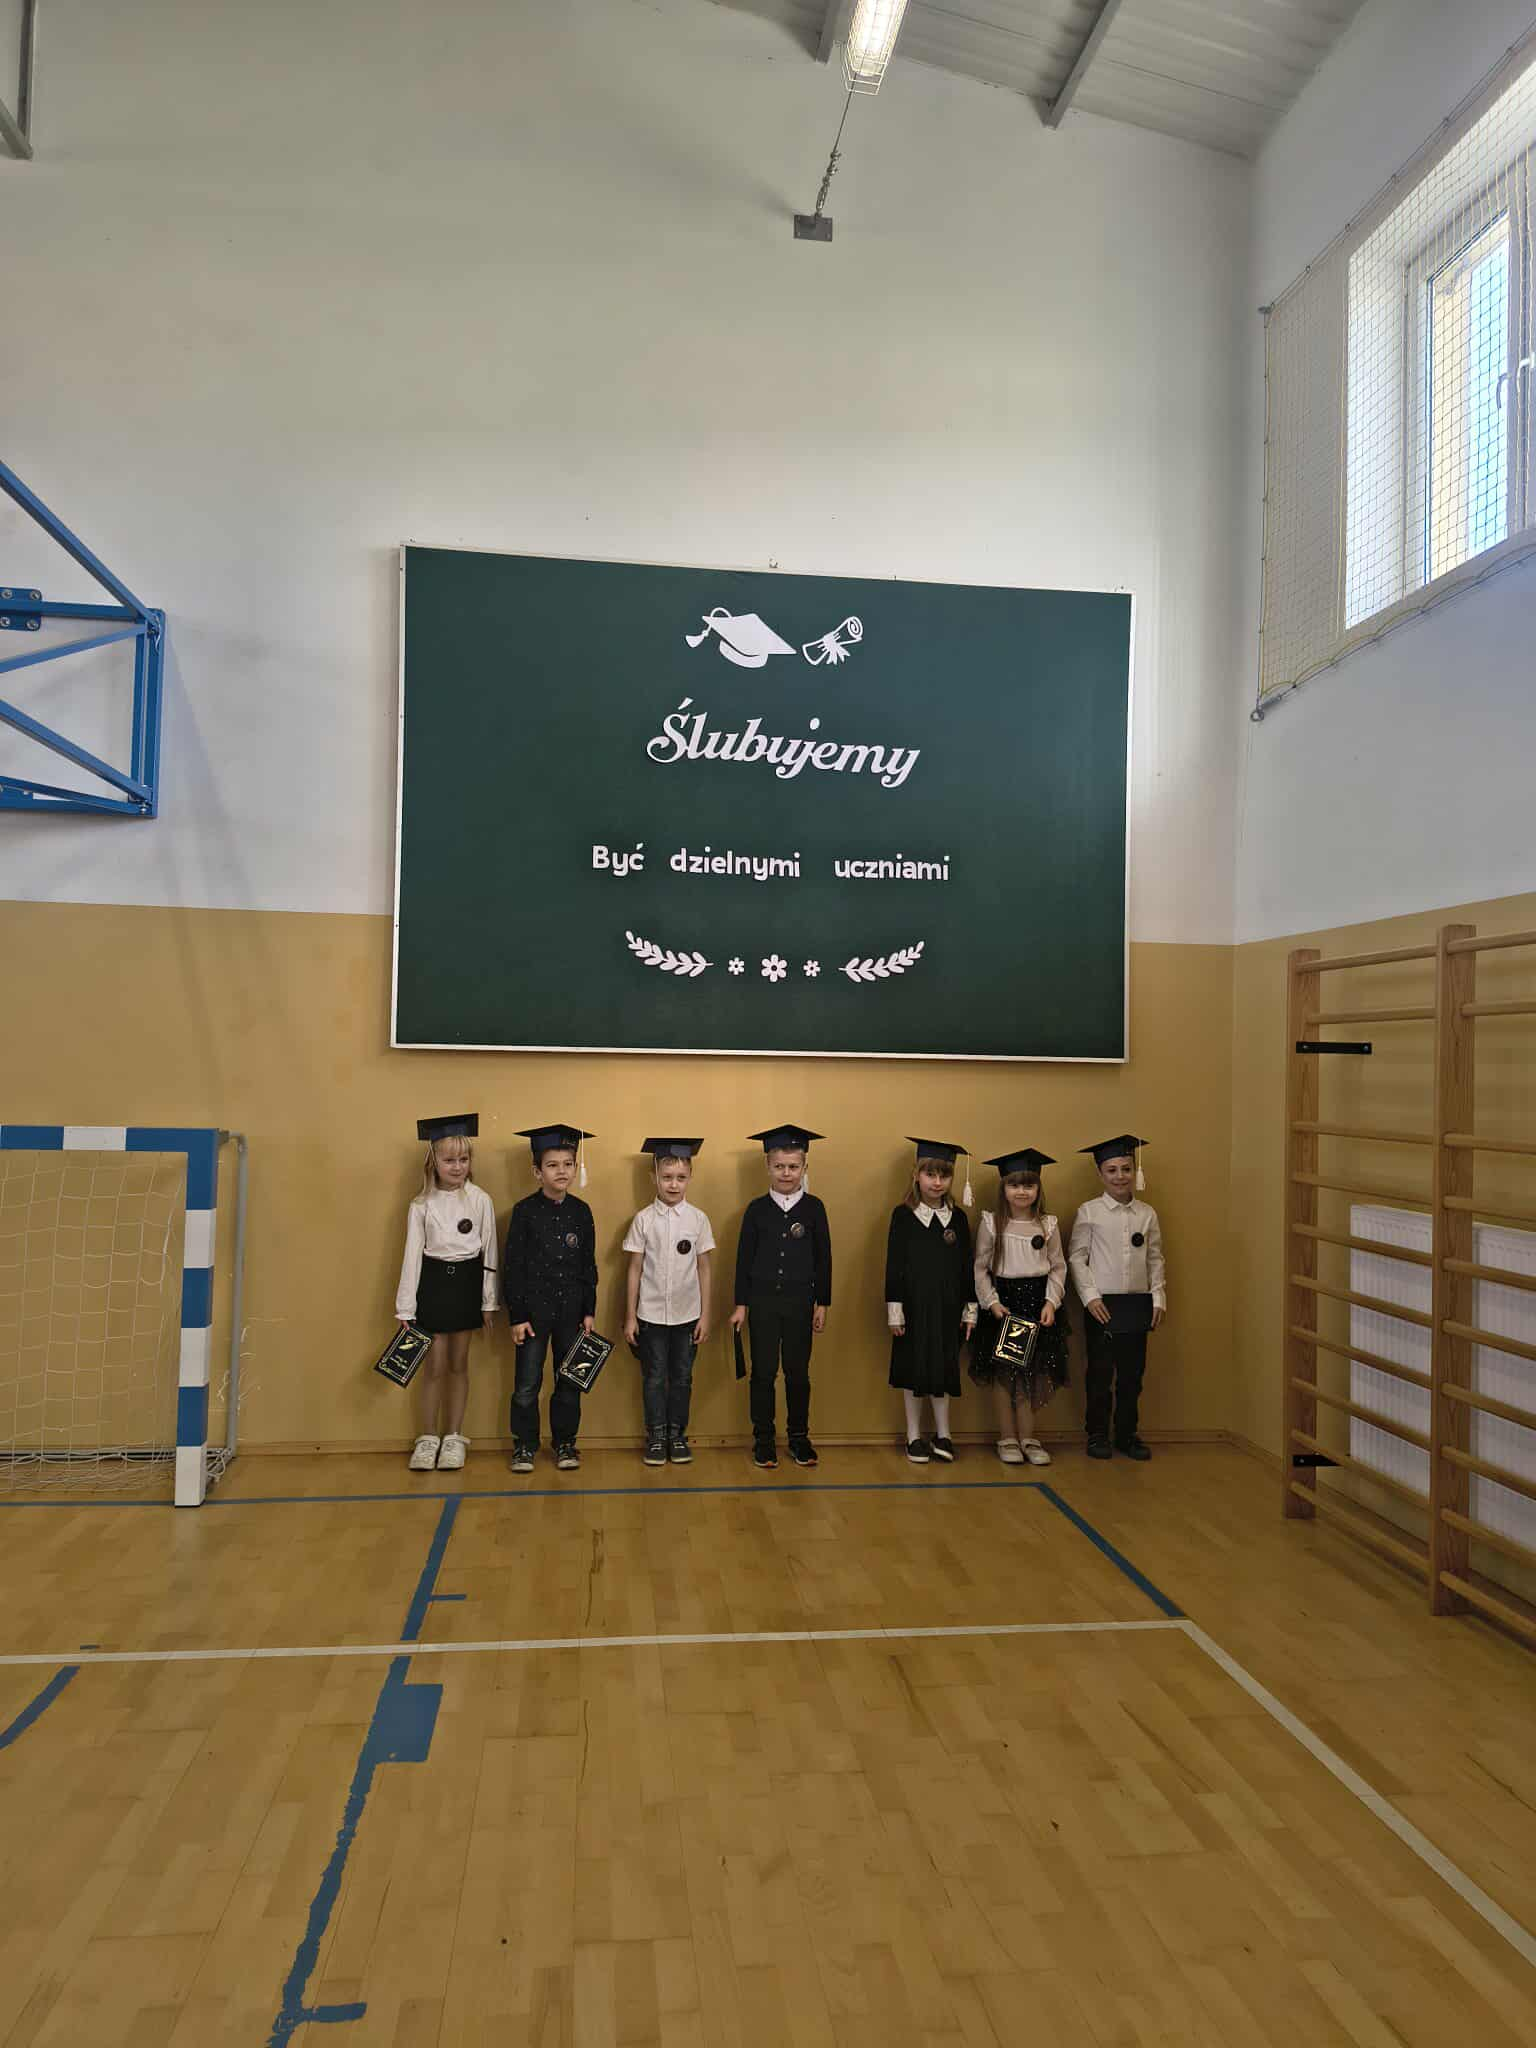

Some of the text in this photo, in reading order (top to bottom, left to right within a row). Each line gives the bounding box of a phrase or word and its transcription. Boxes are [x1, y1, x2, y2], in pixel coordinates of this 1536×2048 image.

[646, 697, 921, 788] Ślubujemy
[592, 842, 950, 881] Być dzielnymi uczniami
